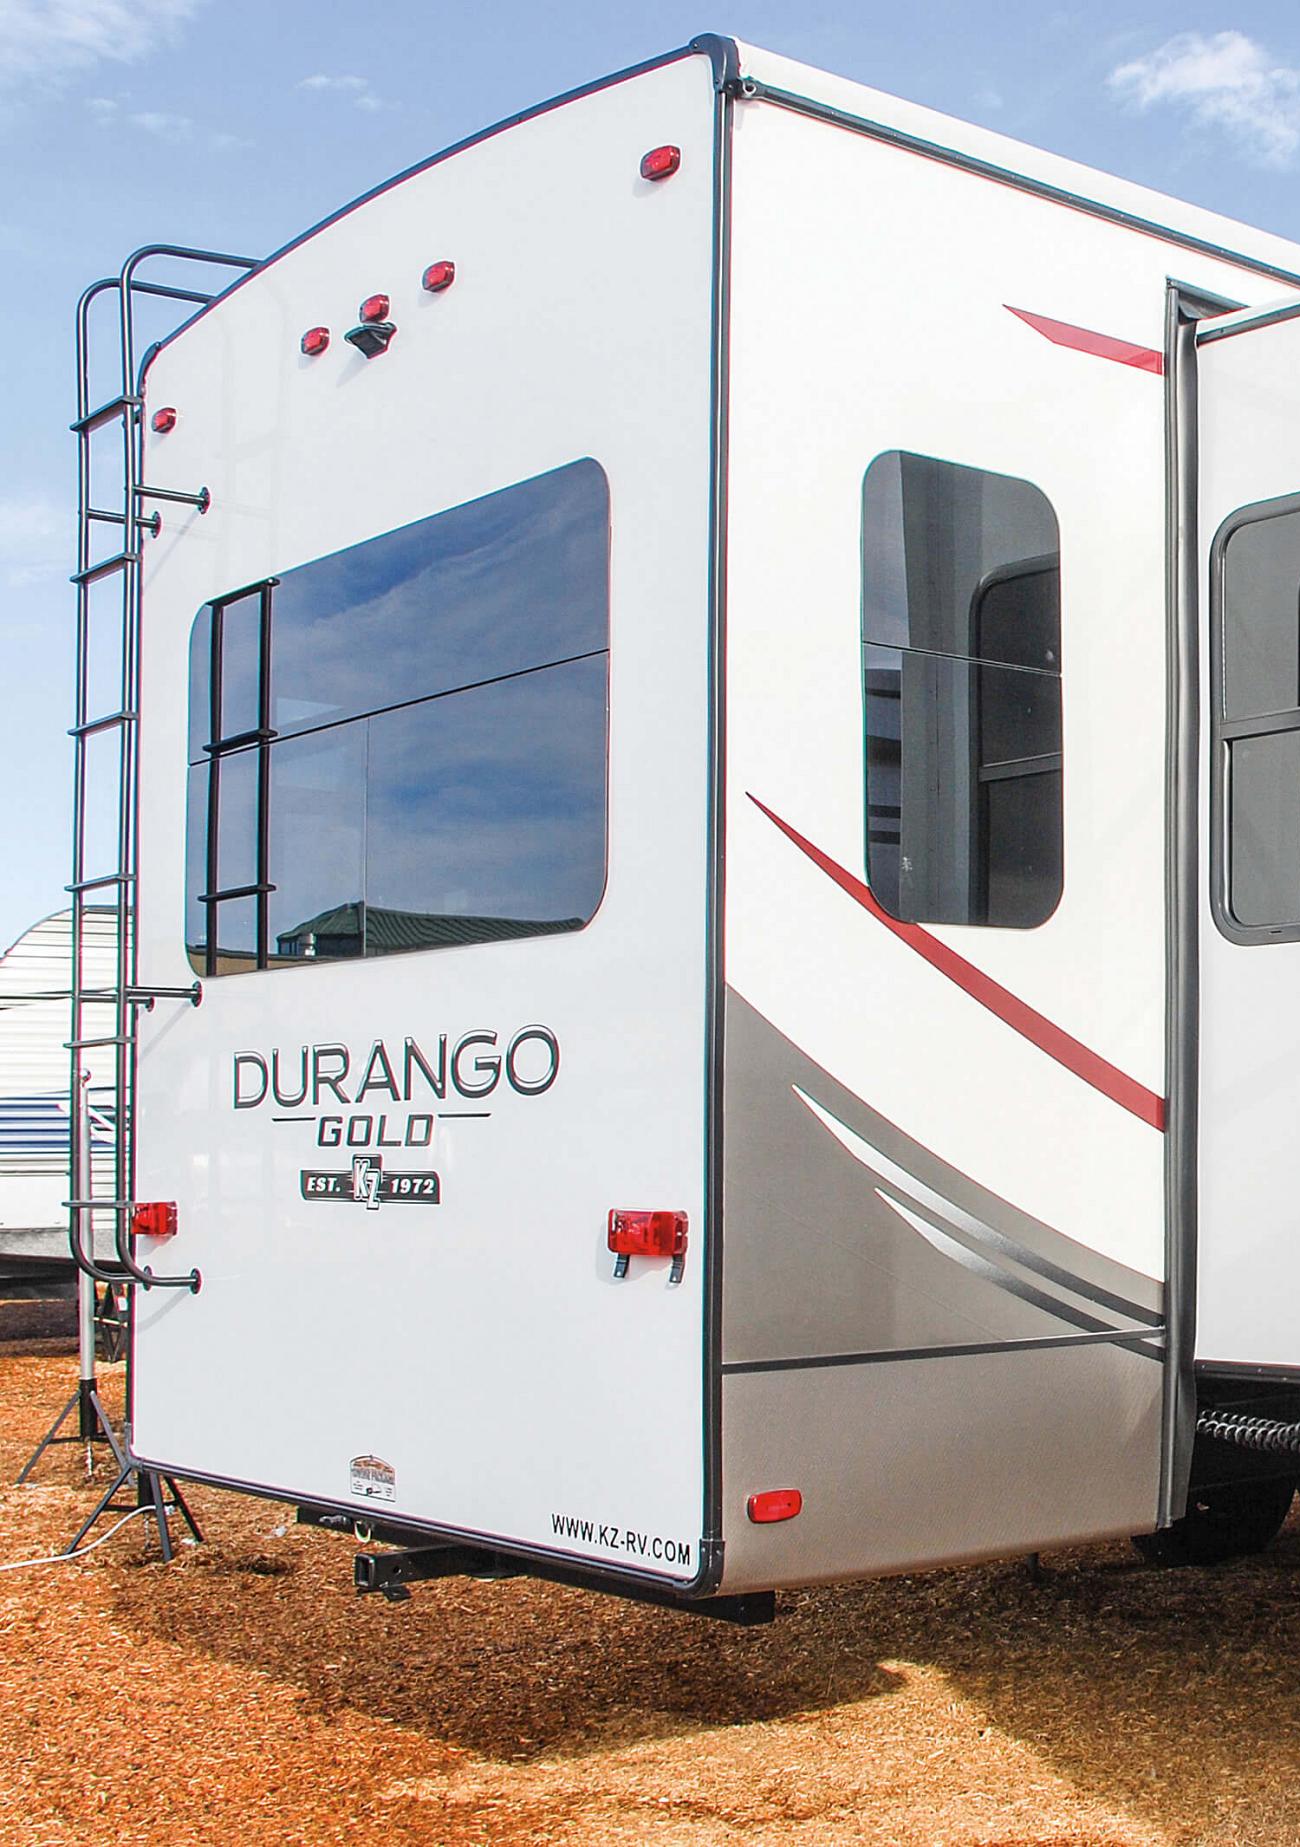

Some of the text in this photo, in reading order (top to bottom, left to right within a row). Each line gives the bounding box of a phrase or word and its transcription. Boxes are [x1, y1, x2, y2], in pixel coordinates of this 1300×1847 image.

[233, 1023, 560, 1109] DURANGO
[317, 1113, 434, 1148] GOLD
[306, 1158, 435, 1210] EST. KZ 1972
[551, 1512, 691, 1566] WWW.KZ-RV.COM
